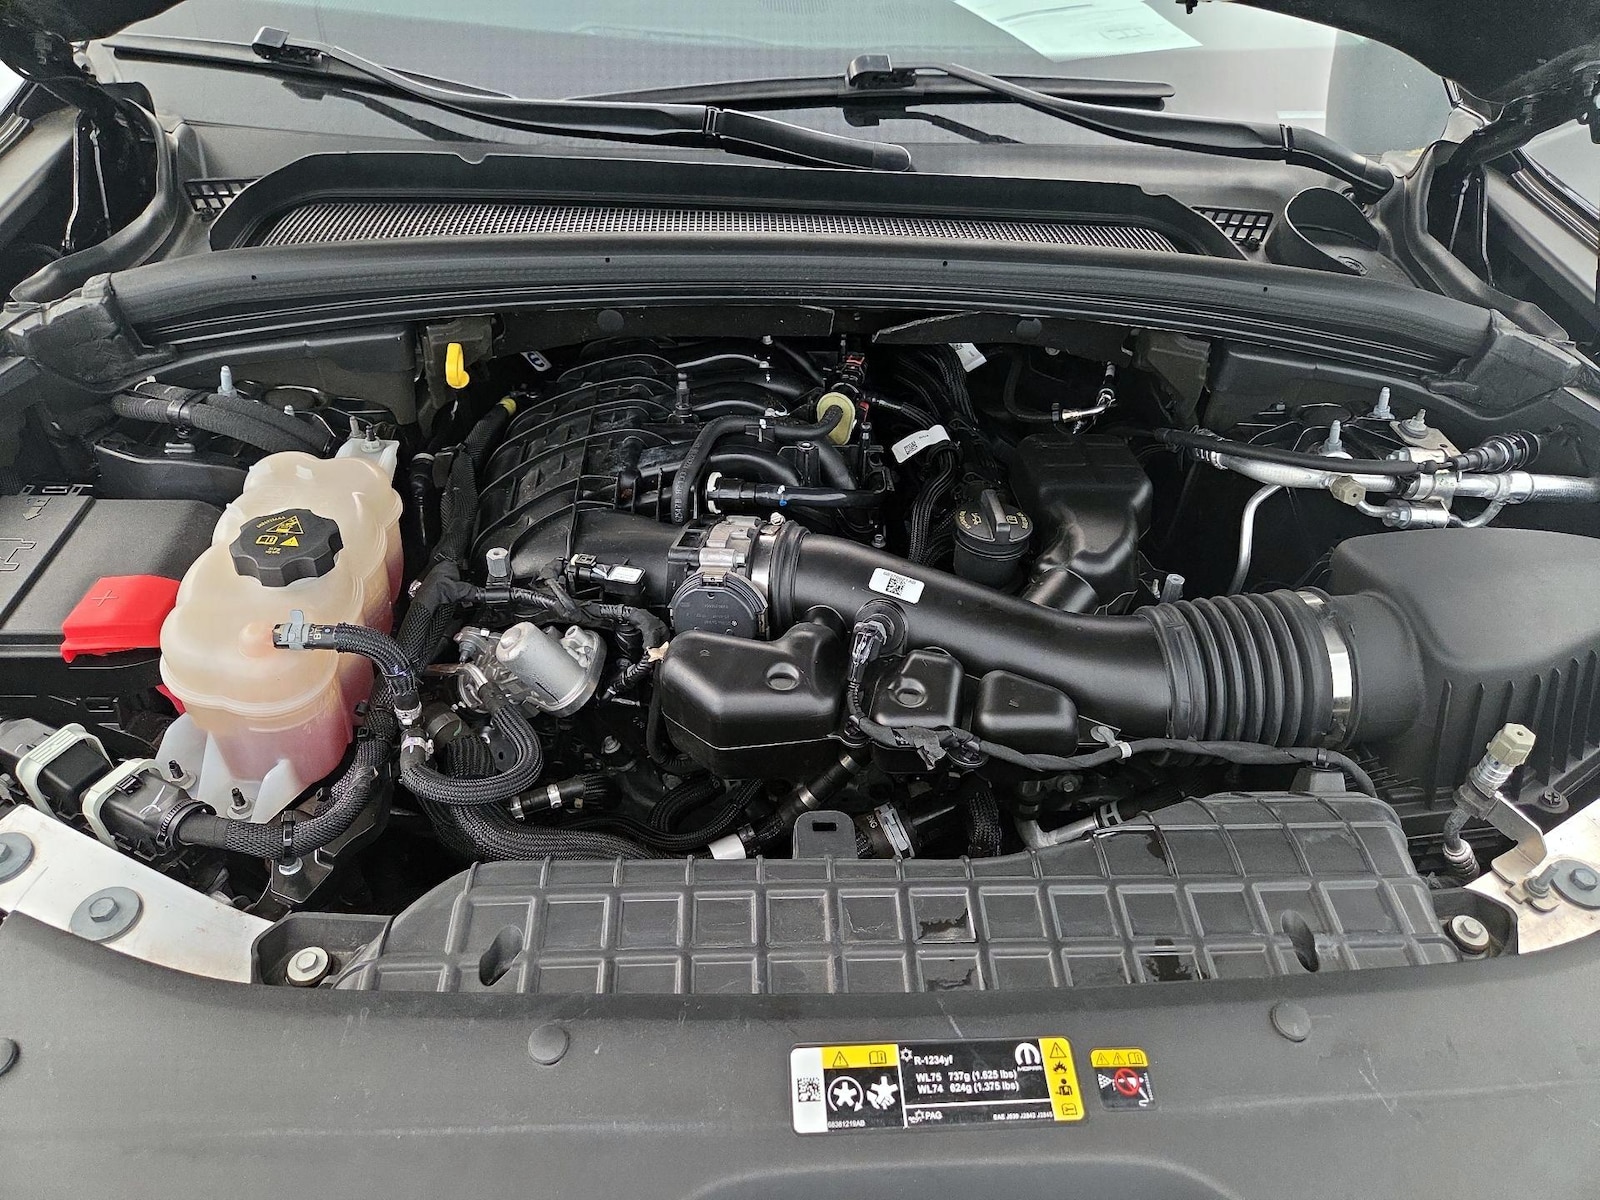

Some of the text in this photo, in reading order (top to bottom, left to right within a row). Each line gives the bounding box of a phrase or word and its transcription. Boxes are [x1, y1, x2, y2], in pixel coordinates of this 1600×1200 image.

[916, 1069, 1018, 1083] WL75 737g (1.625 lbs)
[917, 1081, 1020, 1094] WL74 624g (1.375 lbs)
[925, 1110, 943, 1120] PAG
